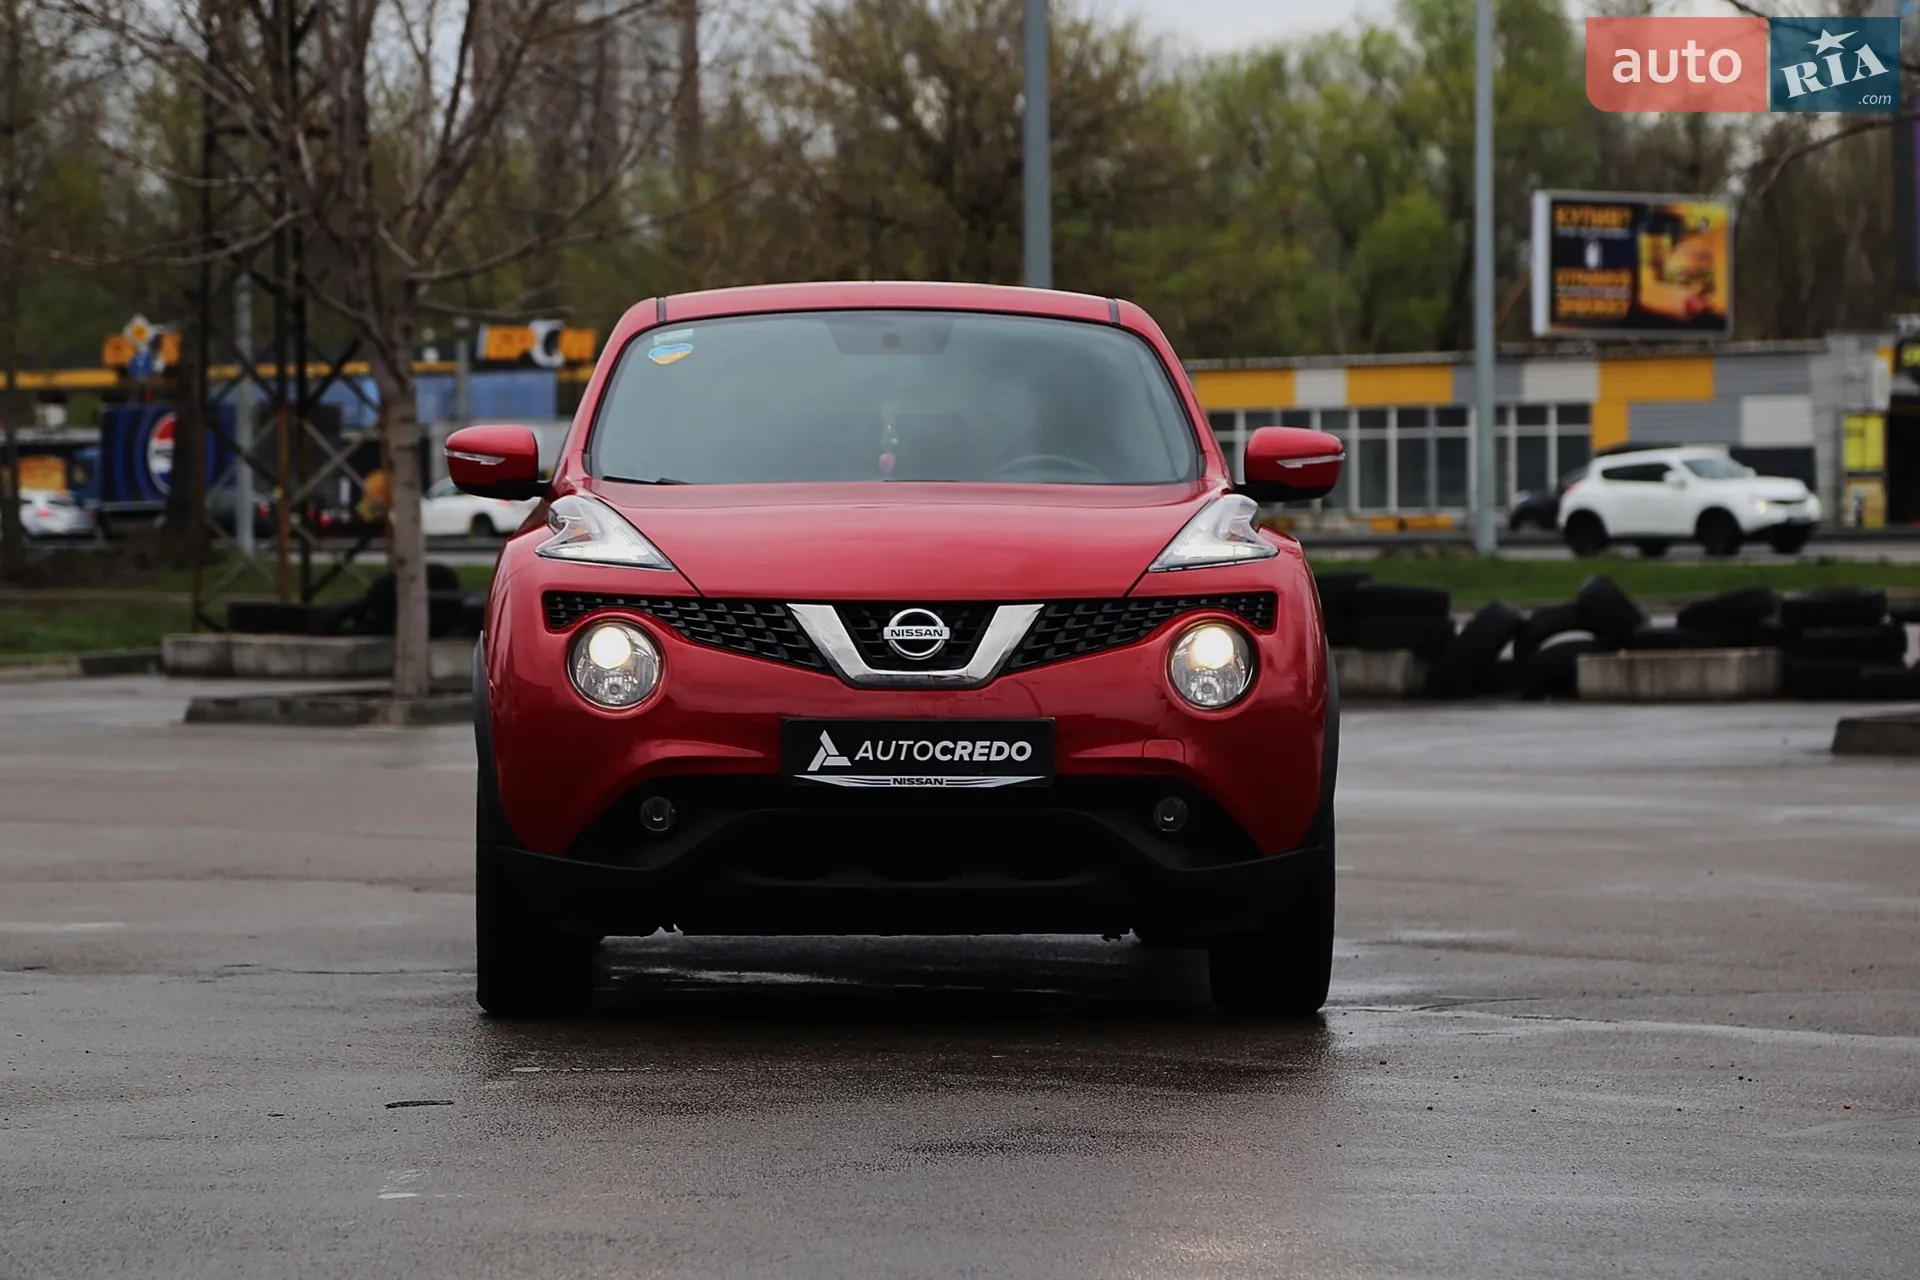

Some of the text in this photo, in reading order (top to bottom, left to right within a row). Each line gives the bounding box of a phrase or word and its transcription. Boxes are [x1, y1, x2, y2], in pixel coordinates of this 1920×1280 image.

[890, 629, 943, 637] NISSAN
[854, 740, 1032, 762] AUTOCREDO
[892, 778, 944, 786] NISSAN
